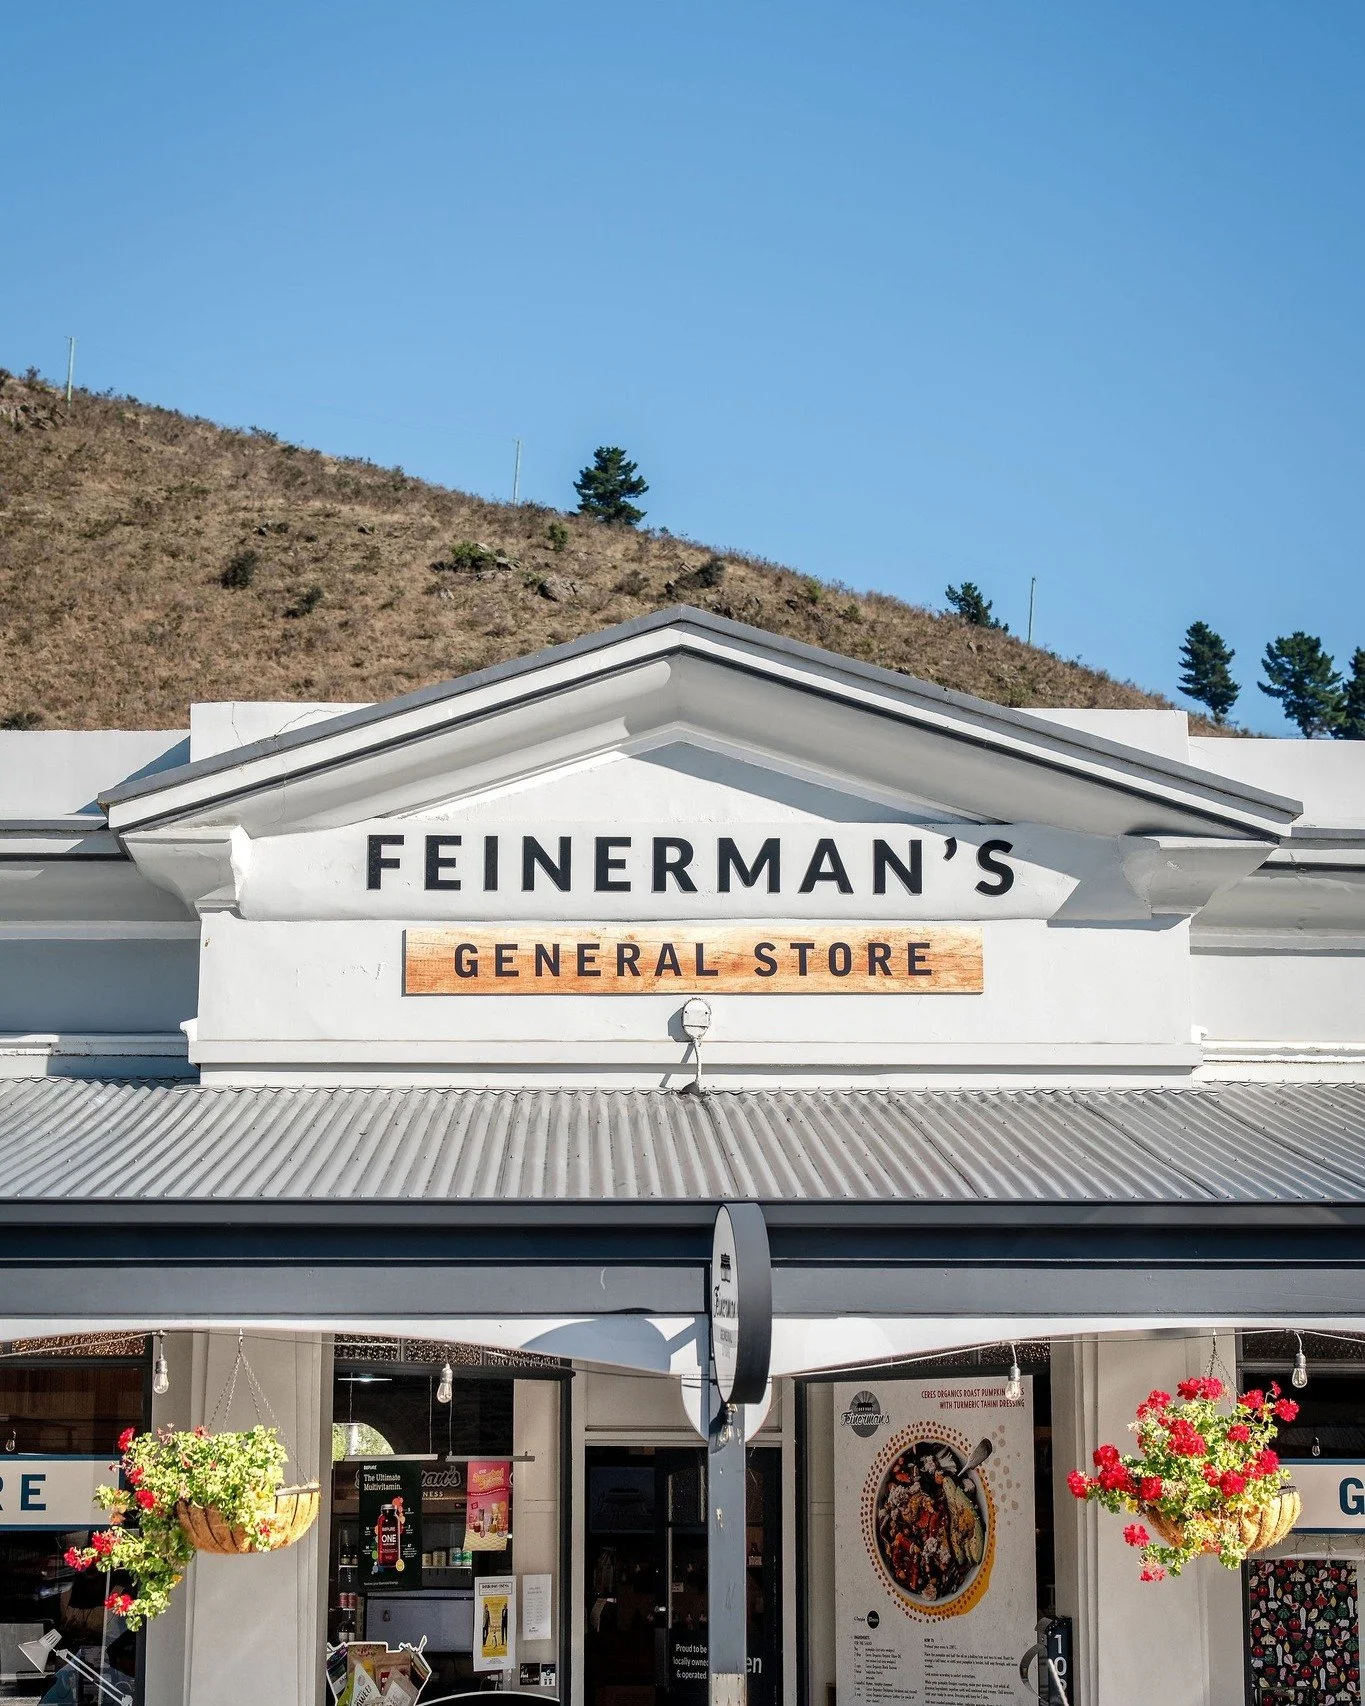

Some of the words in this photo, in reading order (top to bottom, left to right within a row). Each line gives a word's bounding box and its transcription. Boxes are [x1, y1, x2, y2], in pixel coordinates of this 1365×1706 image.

[366, 835, 1015, 896] FEINERMAN'S
[454, 942, 719, 978] GENERAL
[754, 942, 934, 977] STORE
[921, 1390, 936, 1399] CERES
[937, 1389, 962, 1398] ORGANICS
[963, 1388, 980, 1397] ROAST
[981, 1387, 1006, 1397] PUMPKIN
[939, 1401, 953, 1410] WITH
[953, 1400, 980, 1409] TURMERIC
[981, 1399, 999, 1408] TAHINI
[999, 1399, 1025, 1408] DRESSING
[363, 1473, 375, 1482] The
[376, 1473, 401, 1481] Ultimate
[363, 1482, 402, 1491] Multivitamin.
[0, 1474, 47, 1511] E
[1339, 1477, 1365, 1515] G
[381, 1534, 397, 1543] ONE
[675, 1643, 693, 1653] Proud
[693, 1645, 700, 1653] to
[700, 1645, 707, 1653] be
[673, 1656, 691, 1667] locally
[676, 1670, 682, 1679] &
[682, 1671, 707, 1680] operated
